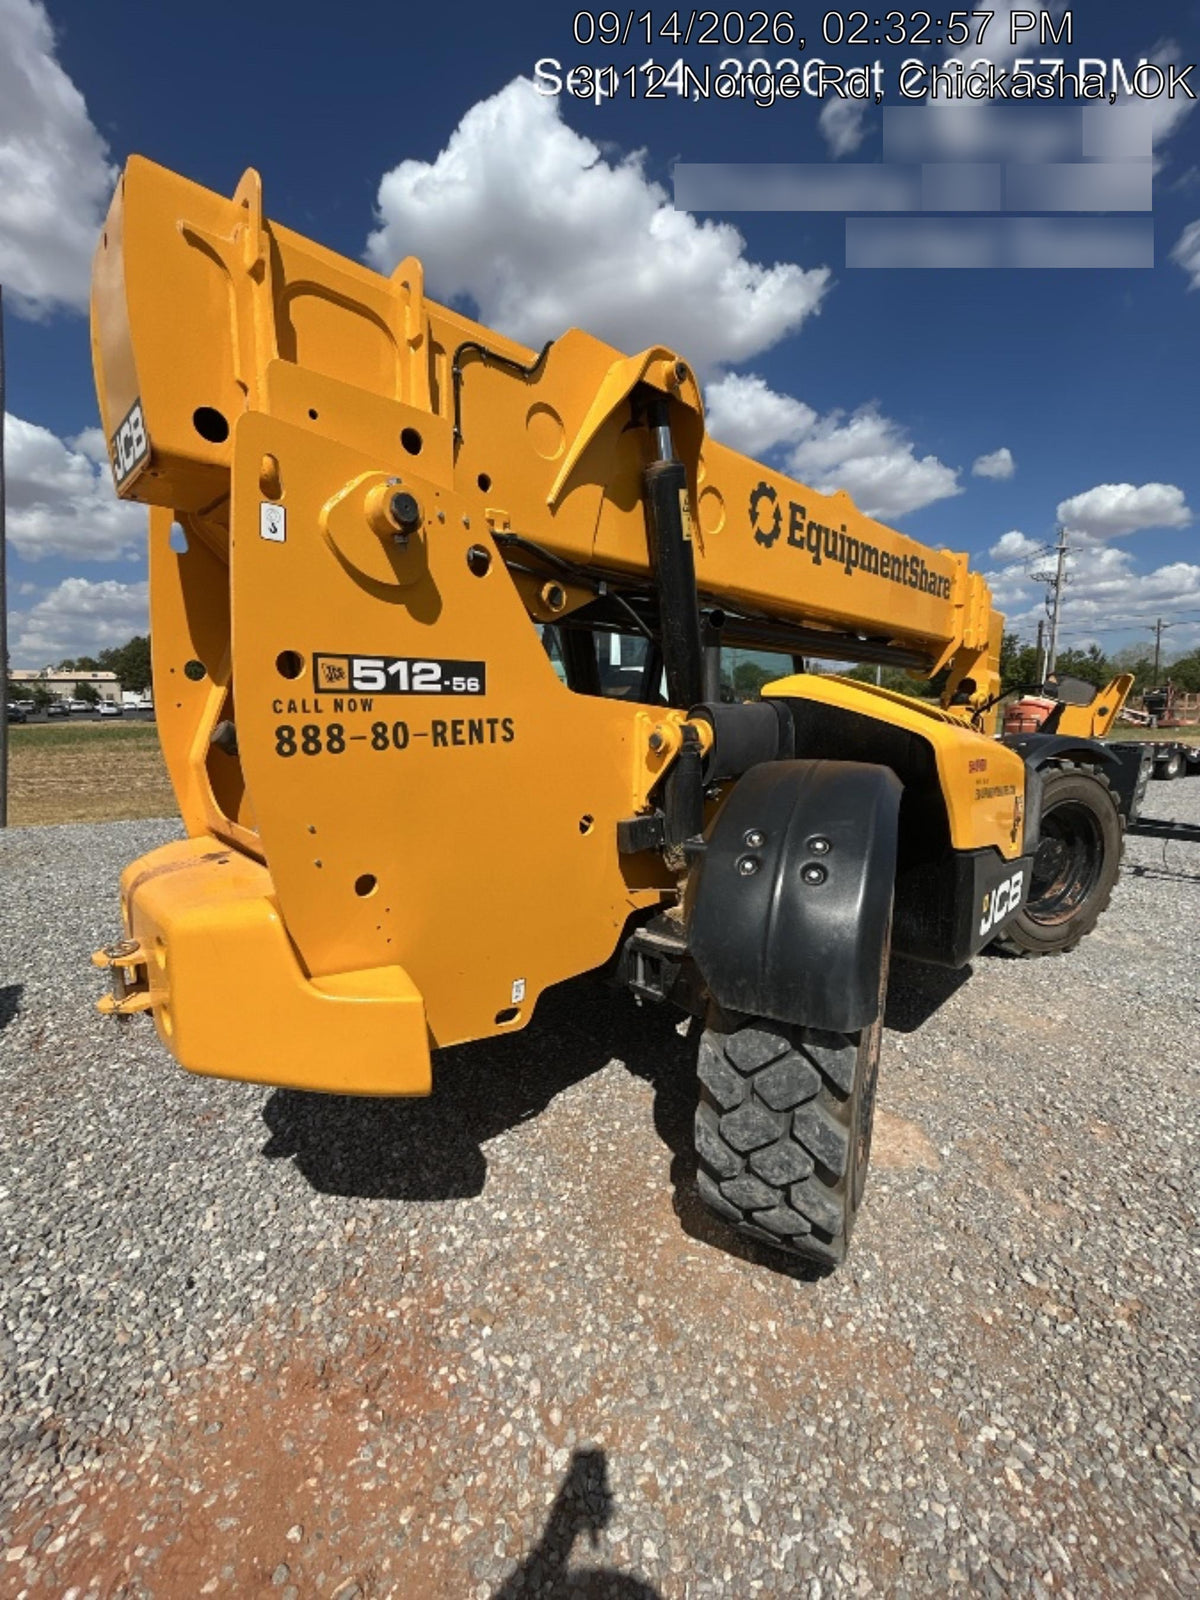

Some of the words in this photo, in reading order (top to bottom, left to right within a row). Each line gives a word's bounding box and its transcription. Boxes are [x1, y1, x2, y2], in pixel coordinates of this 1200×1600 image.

[113, 404, 147, 481] JCB
[787, 501, 951, 600] EquipmentShare
[272, 699, 324, 714] CALL
[333, 698, 374, 713] NOW
[275, 717, 515, 758] 888-80-RENTS
[979, 870, 1024, 936] JCB
